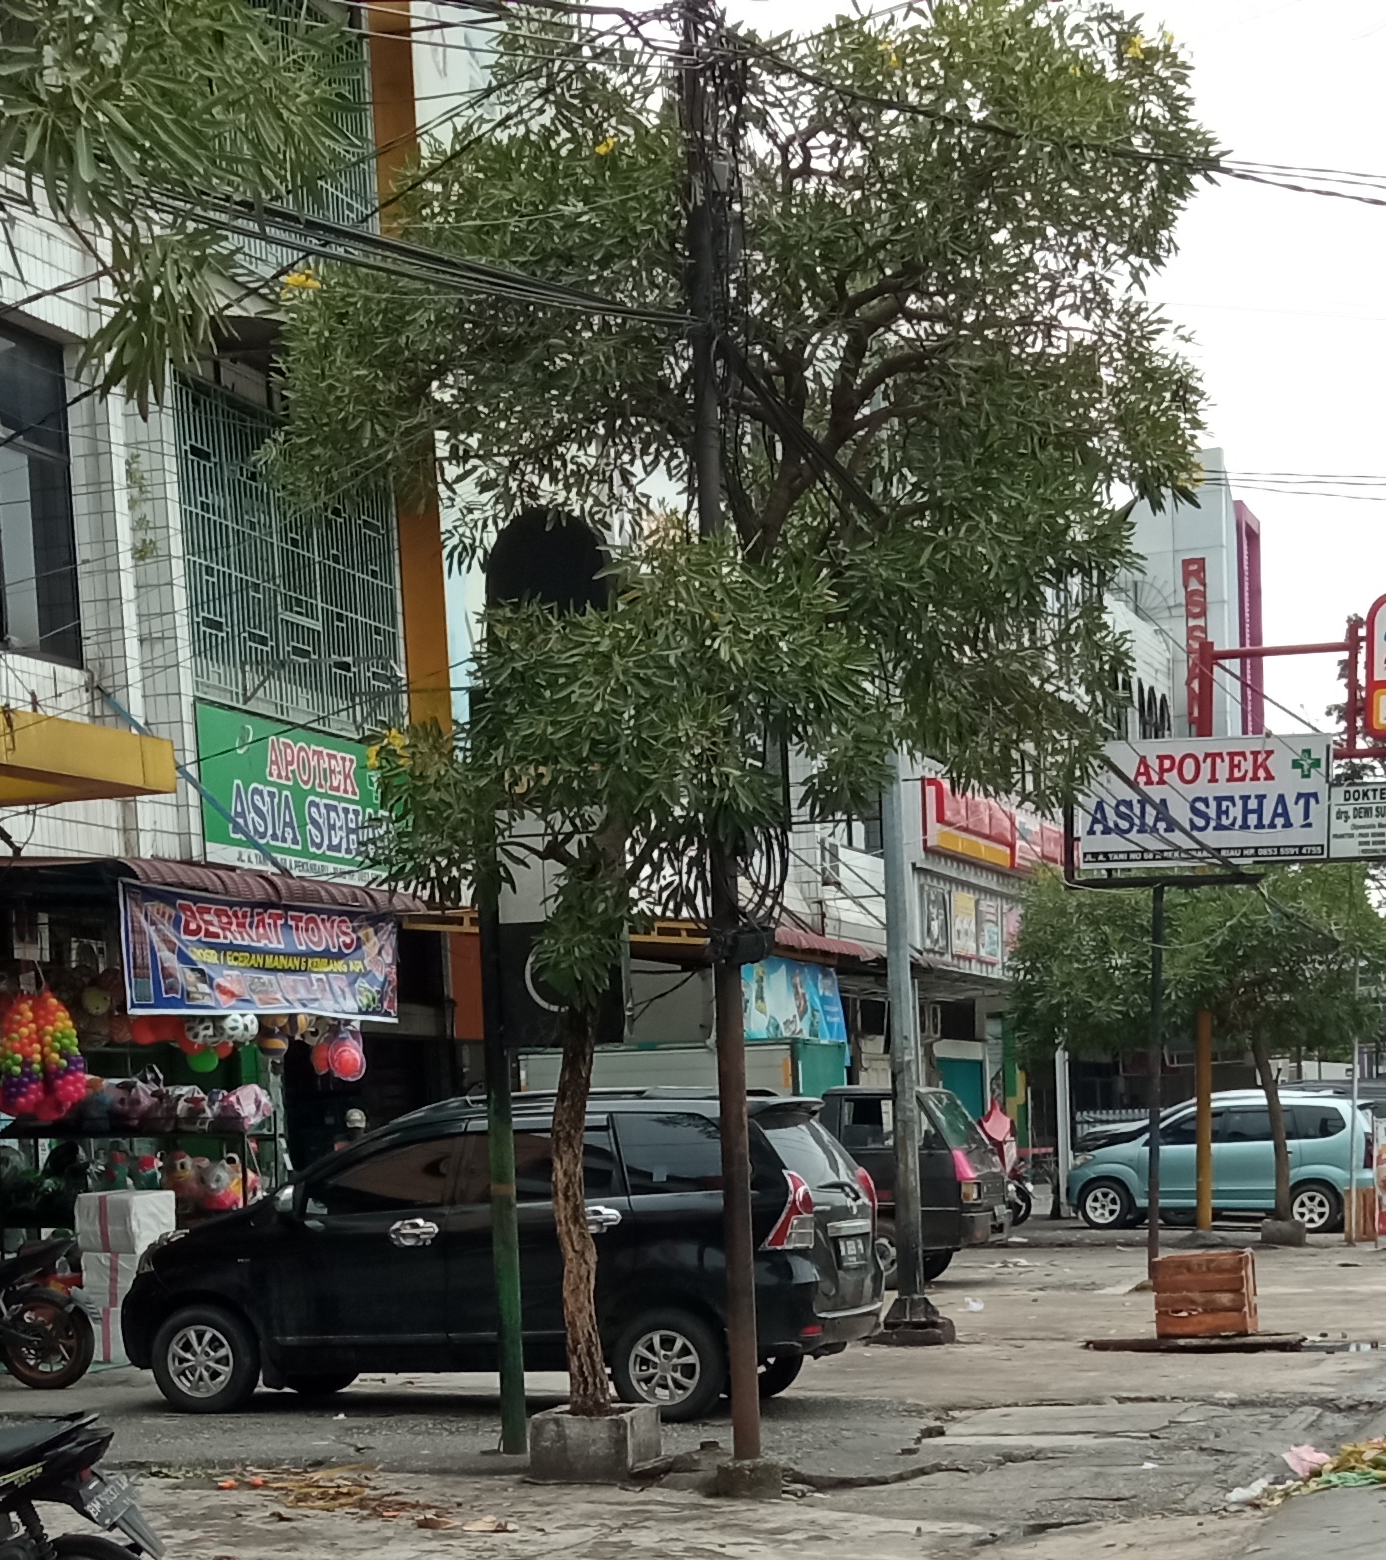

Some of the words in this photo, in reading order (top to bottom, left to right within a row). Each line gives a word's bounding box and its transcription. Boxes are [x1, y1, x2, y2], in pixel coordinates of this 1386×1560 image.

[267, 736, 359, 799] APOTEK
[1133, 750, 1275, 786] APOTEK
[230, 780, 301, 849] ASIA
[1087, 799, 1175, 836] ASIA
[1189, 792, 1320, 833] SEHAT
[1336, 808, 1350, 823] drg.
[1352, 806, 1373, 819] DEWI
[1220, 849, 1241, 857] RIAU
[177, 900, 286, 948] BERKAT
[288, 910, 357, 953] TOYS
[226, 951, 264, 968] ECERAN
[265, 954, 301, 971] MAINAN
